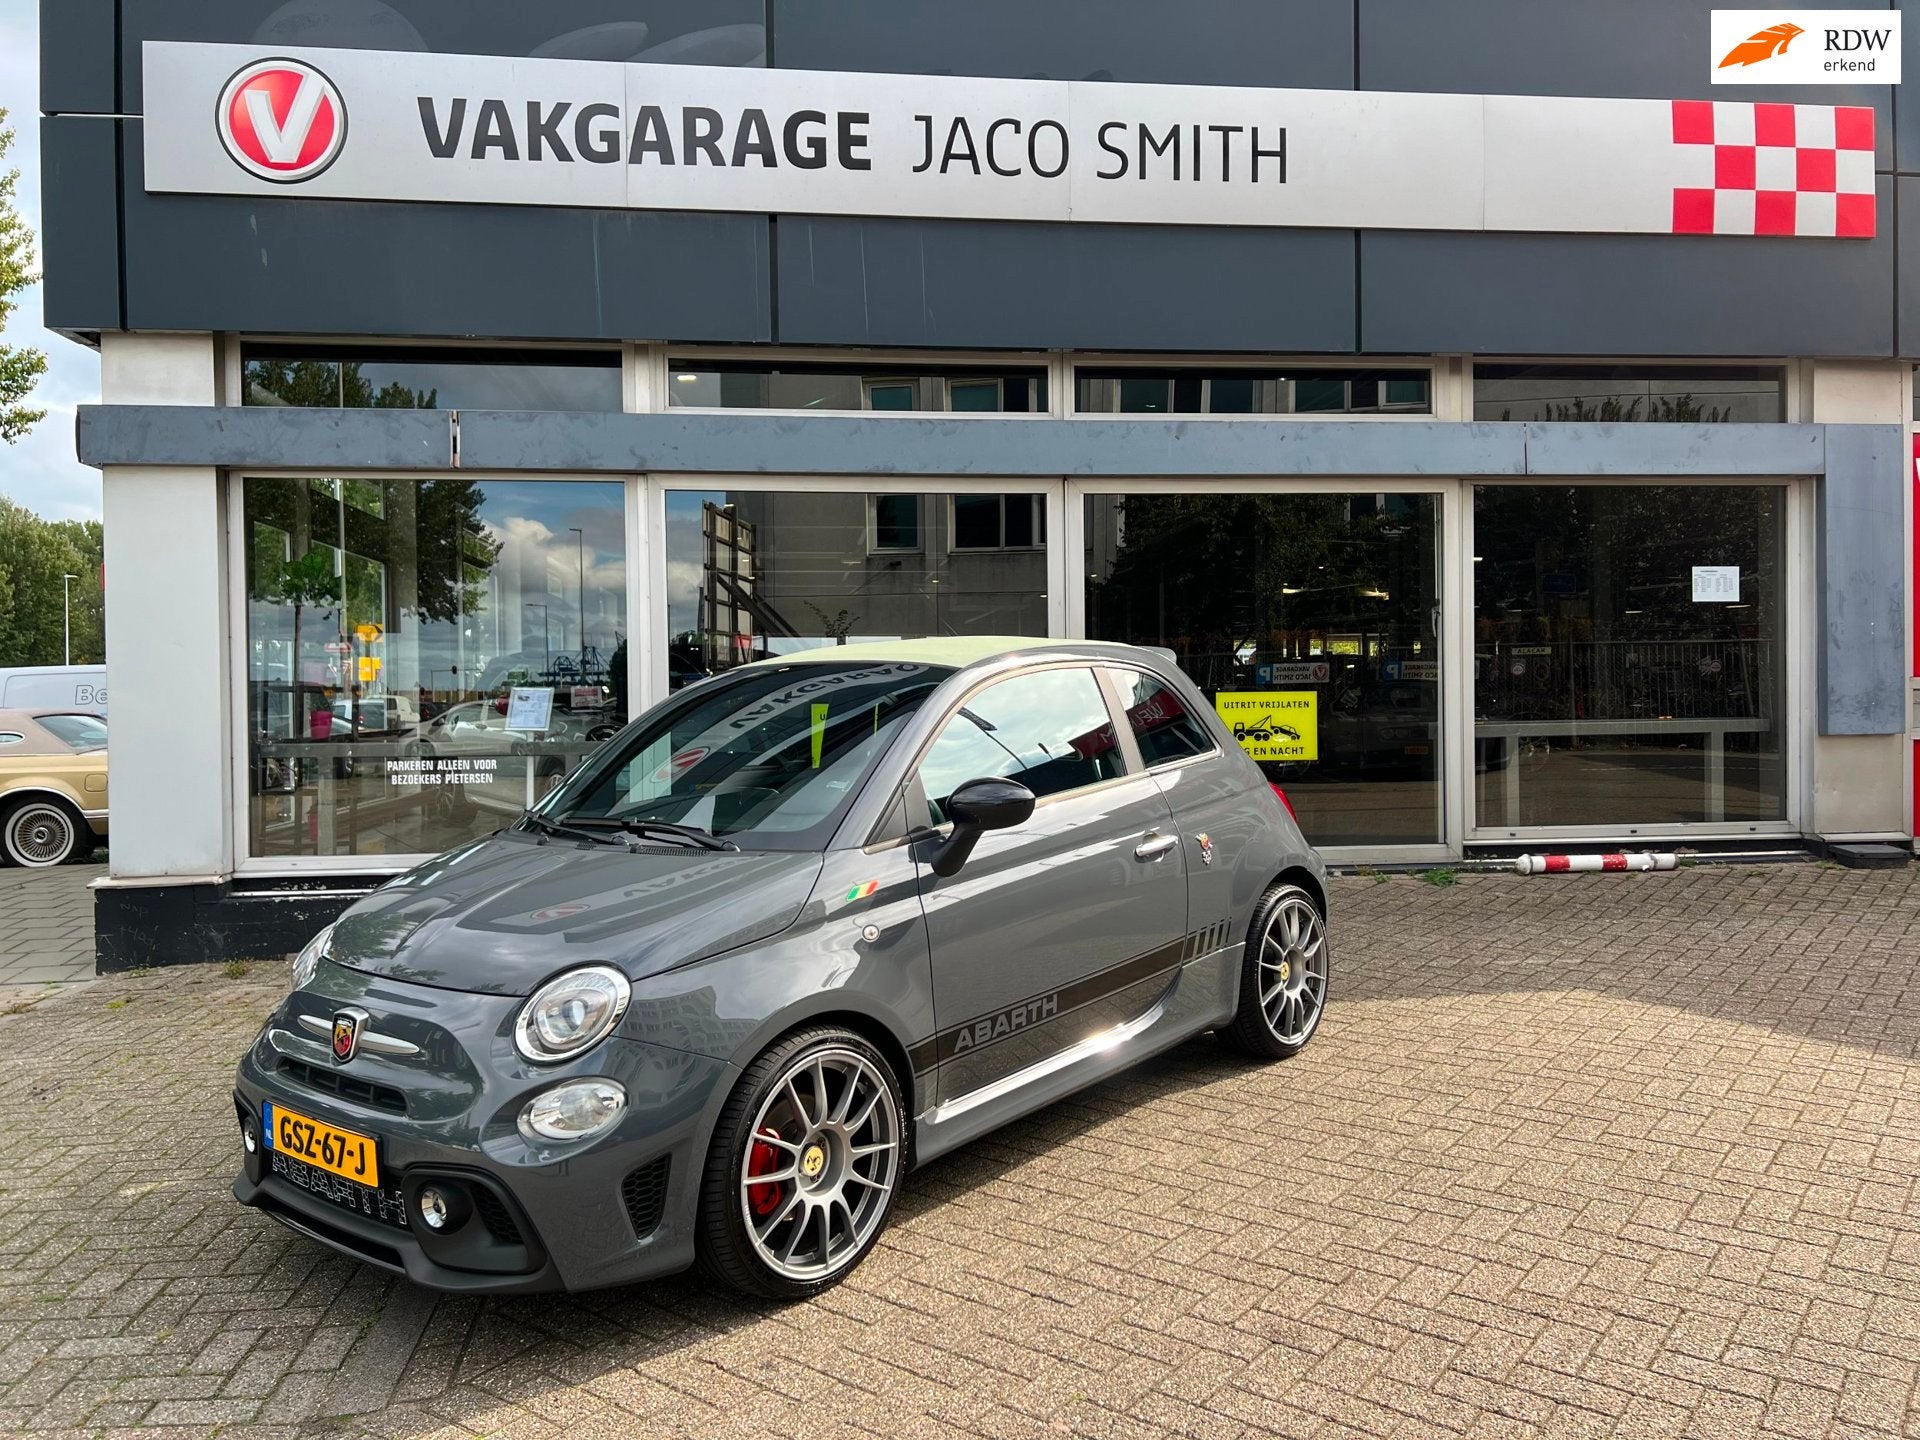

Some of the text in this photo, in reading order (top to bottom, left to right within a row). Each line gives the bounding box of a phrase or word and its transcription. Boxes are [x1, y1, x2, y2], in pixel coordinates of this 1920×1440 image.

[417, 96, 1287, 184] VAKGARAGE JACO SMITH
[1223, 700, 1310, 709] UITRIT VRIJLATEN
[387, 759, 498, 771] PARKEREN ALLEEN VOOR
[1253, 747, 1267, 755] EN
[1270, 746, 1305, 755] NACHT
[391, 772, 493, 785] BEZOEKERS PIETERSEN
[953, 993, 1059, 1054] ABARTH
[280, 1115, 366, 1176] GSZ-67-J
[272, 1151, 408, 1226] ABARTH
